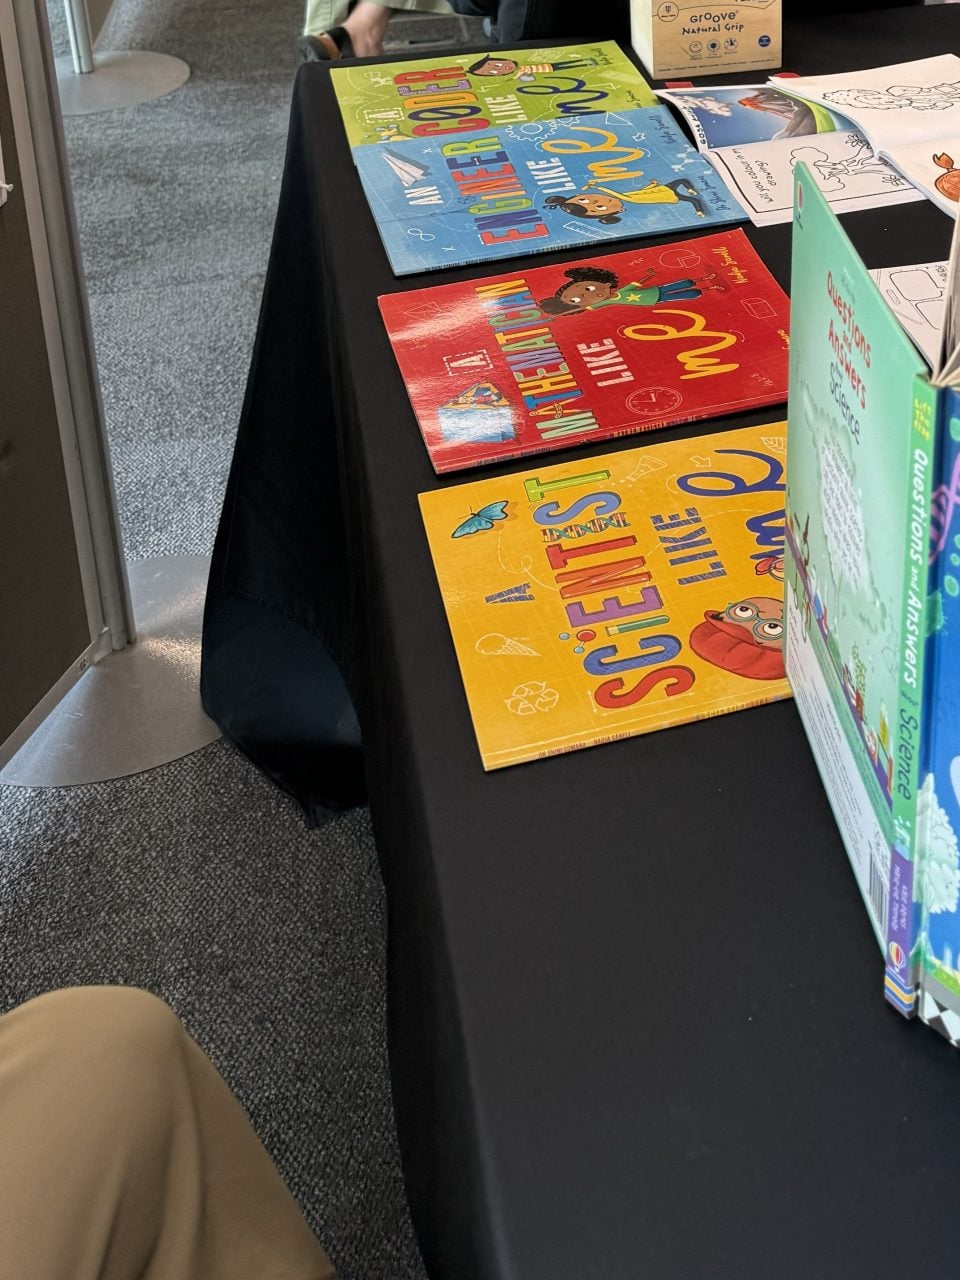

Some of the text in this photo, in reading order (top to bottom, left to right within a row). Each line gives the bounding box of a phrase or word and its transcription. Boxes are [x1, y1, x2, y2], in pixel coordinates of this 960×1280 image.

[682, 23, 744, 35] Natural Grip
[395, 66, 491, 137] CODER
[487, 94, 528, 124] LIKE
[442, 136, 550, 246] ENGINEER
[530, 157, 577, 193] LIKE
[542, 126, 645, 181] me
[404, 185, 444, 206] AN
[623, 309, 740, 380] me
[826, 271, 872, 369] Questions
[450, 353, 484, 368] A
[475, 278, 600, 440] MATHEMATICIAN
[577, 338, 635, 387] LIKE
[828, 319, 868, 410] Answers
[829, 361, 861, 446] Science
[911, 448, 929, 565] Questions
[650, 506, 727, 585] LIKE
[485, 582, 535, 604] A
[524, 470, 696, 709] SCIENTIST
[904, 590, 923, 689] Answers
[898, 715, 920, 801] Science
